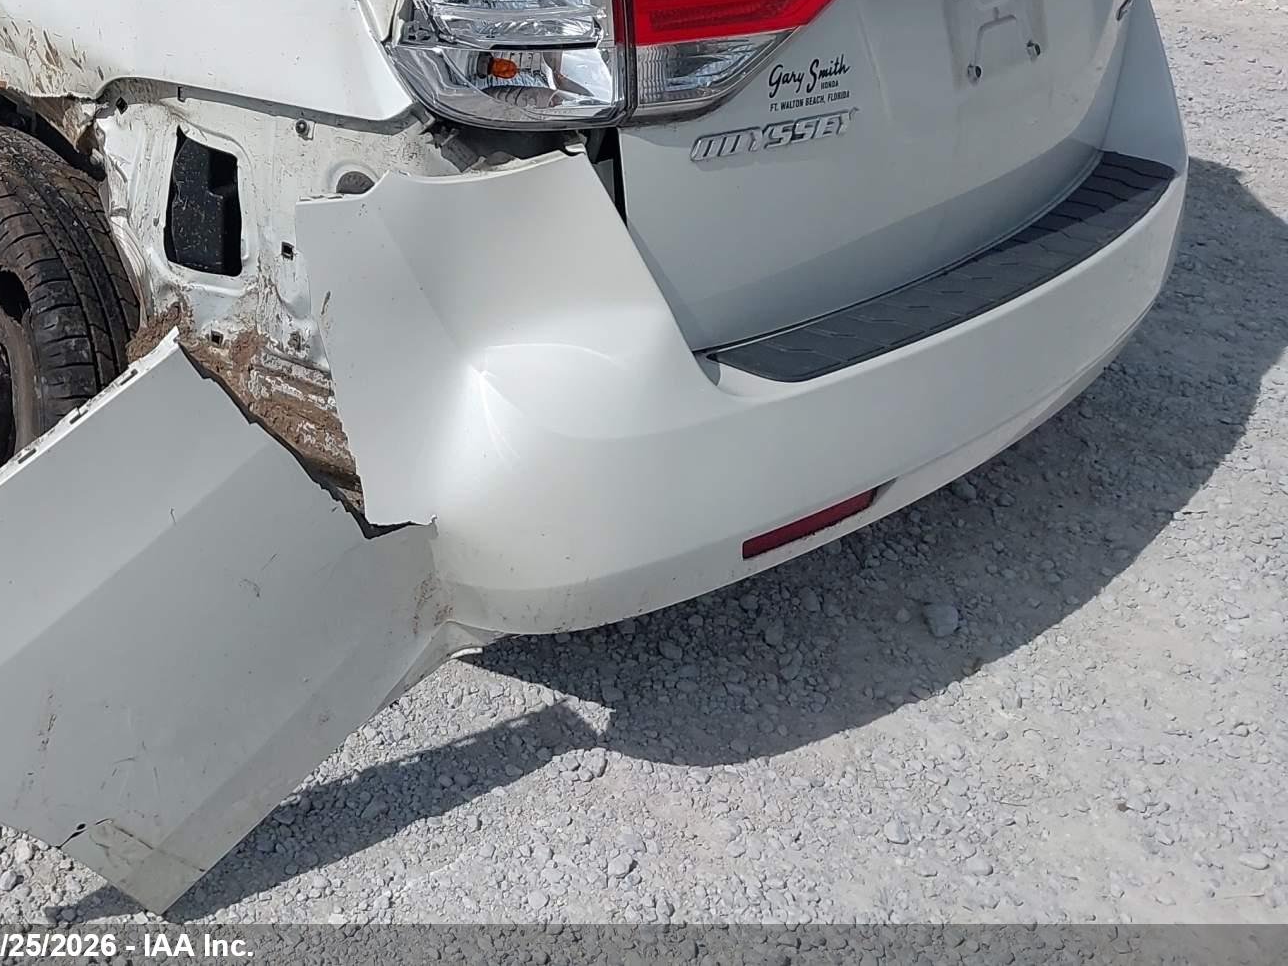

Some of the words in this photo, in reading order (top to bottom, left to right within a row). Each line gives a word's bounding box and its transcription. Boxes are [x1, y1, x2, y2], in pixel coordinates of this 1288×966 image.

[768, 64, 804, 98] Gary
[806, 53, 851, 93] Smith
[820, 80, 839, 90] HONDA
[769, 103, 779, 112] FT.
[780, 99, 804, 111] WALTON
[805, 96, 826, 106] BEACH,
[827, 91, 850, 102] FLORIDA
[690, 106, 859, 162] ODYSSEY
